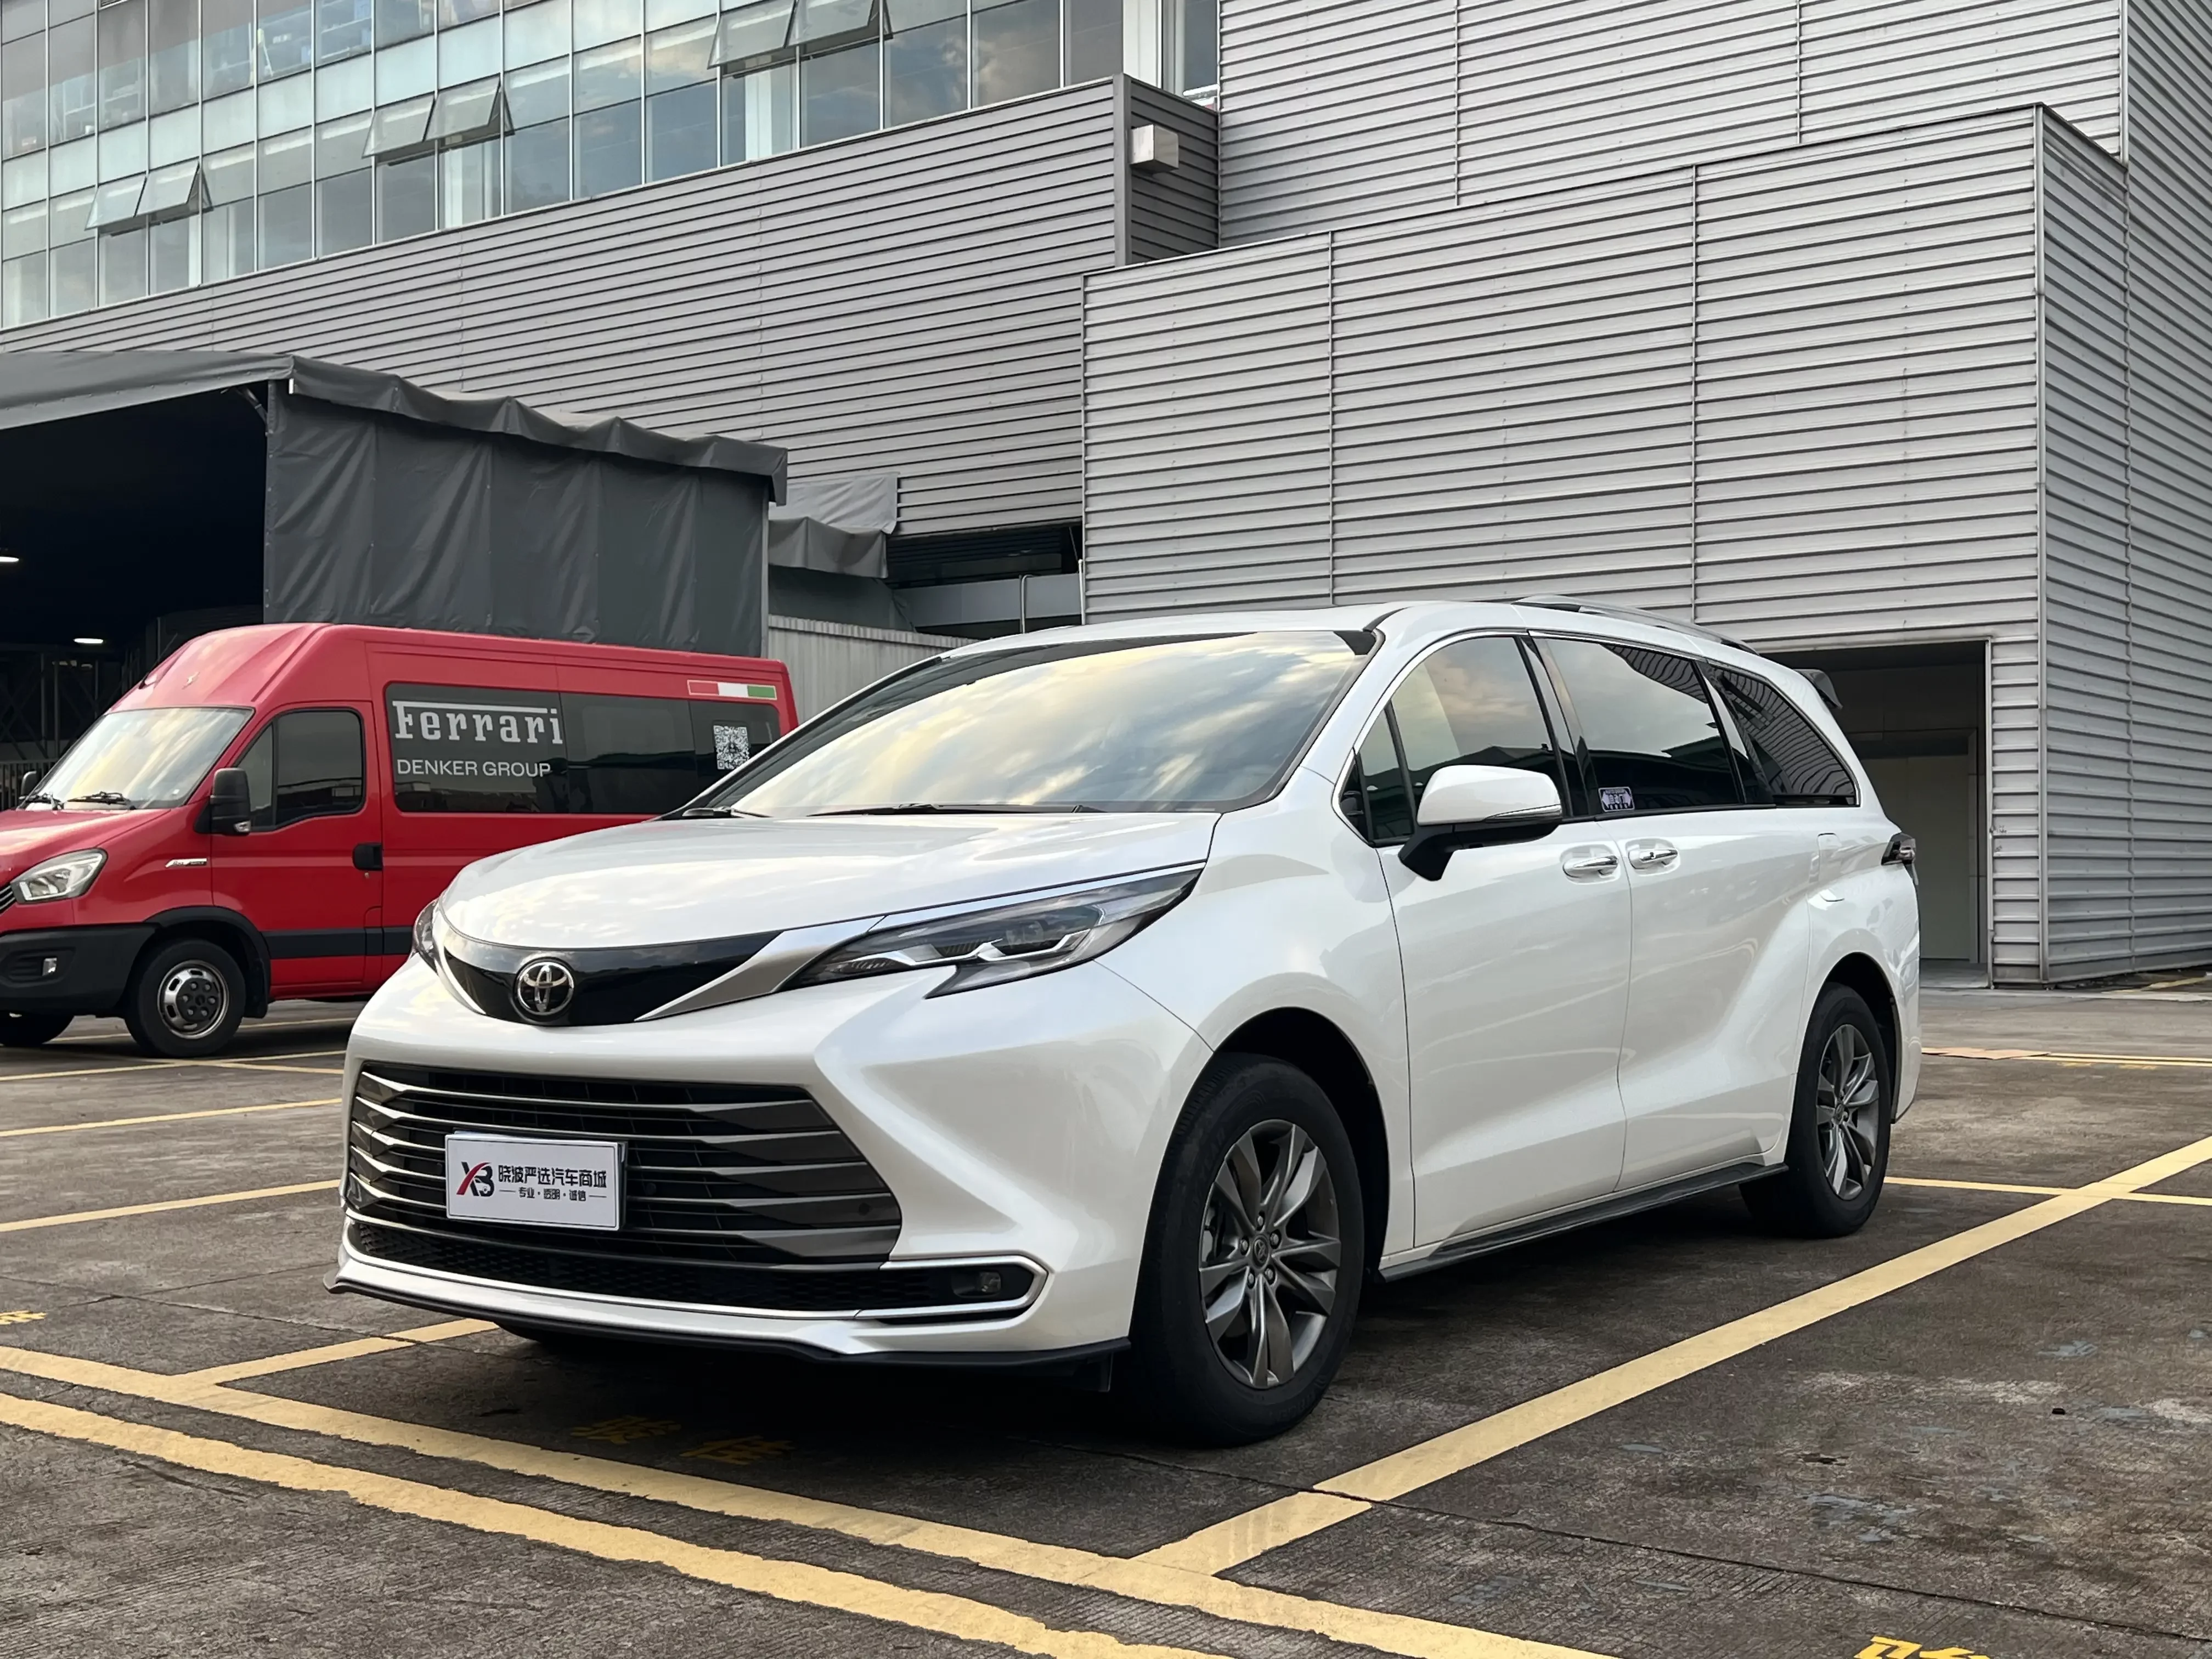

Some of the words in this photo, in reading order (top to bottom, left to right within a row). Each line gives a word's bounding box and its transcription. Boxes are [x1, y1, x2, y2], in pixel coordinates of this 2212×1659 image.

[392, 700, 563, 744] Ferrari
[397, 759, 478, 776] DENKER
[482, 761, 551, 777] GROUP
[498, 1165, 607, 1188] 晓波严选汽车商城
